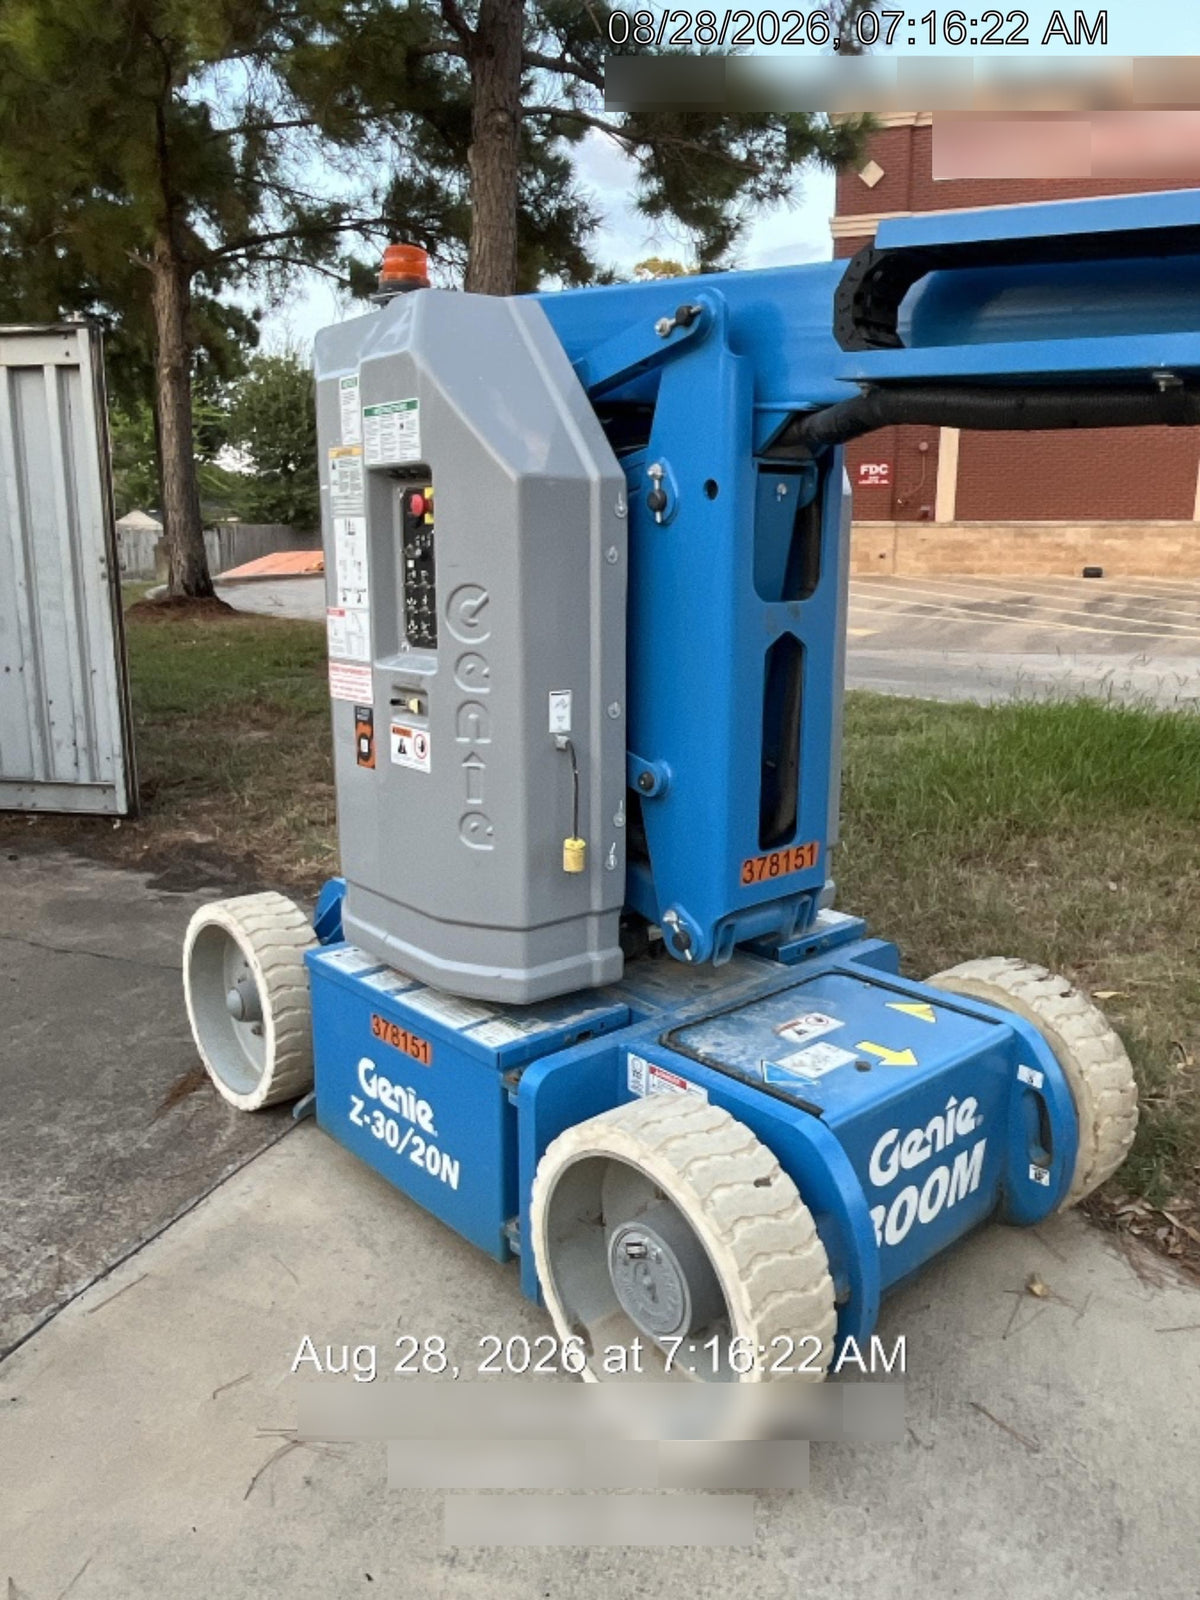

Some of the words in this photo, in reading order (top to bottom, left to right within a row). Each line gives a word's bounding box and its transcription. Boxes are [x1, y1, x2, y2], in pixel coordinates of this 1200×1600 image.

[860, 464, 889, 475] FDC
[742, 843, 815, 884] 378151
[371, 1014, 430, 1063] 378151
[357, 1057, 434, 1134] Genie
[349, 1094, 460, 1190] Z-30/20N
[868, 1095, 978, 1187] Genie
